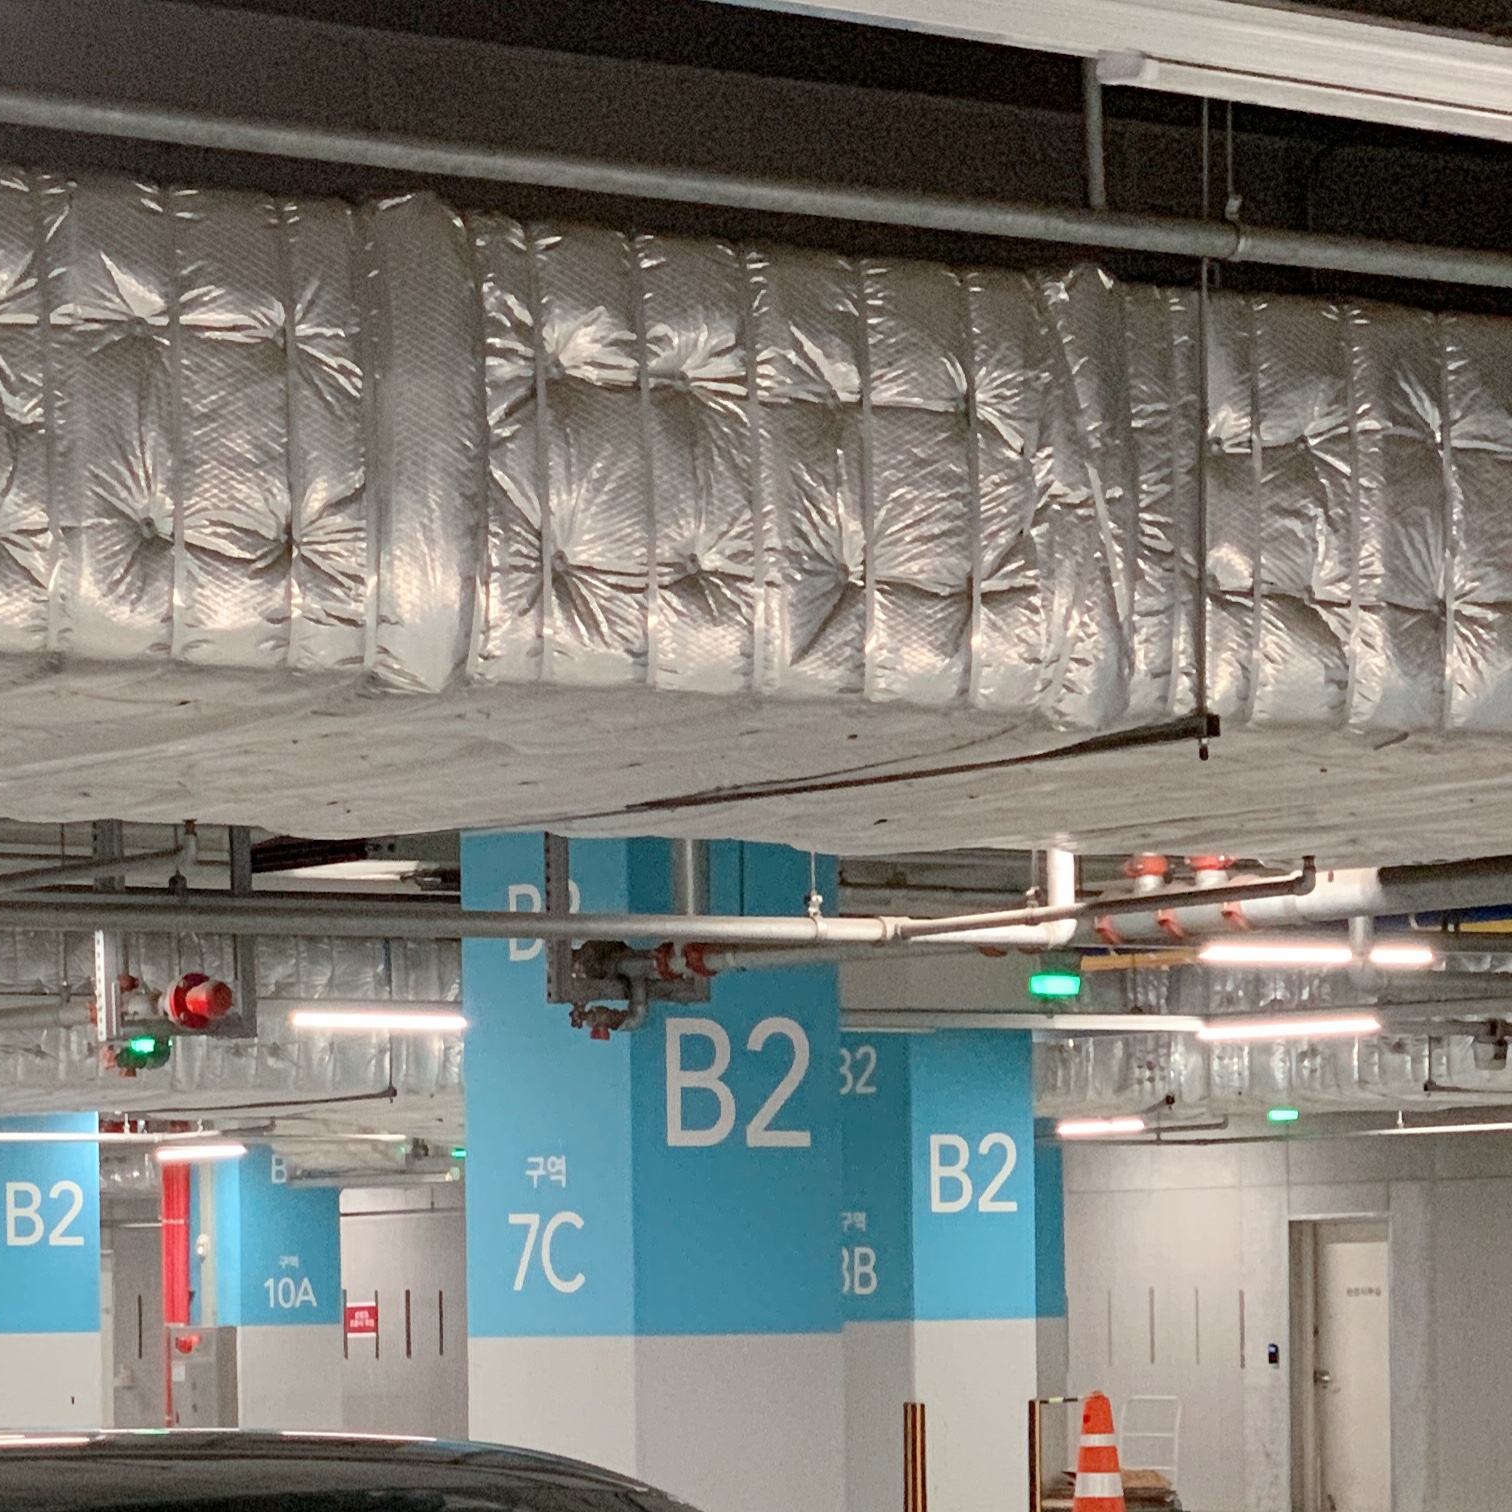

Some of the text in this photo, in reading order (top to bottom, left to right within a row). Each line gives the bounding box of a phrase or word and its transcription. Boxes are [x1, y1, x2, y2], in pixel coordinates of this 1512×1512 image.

[666, 1017, 811, 1147] B2
[271, 1154, 288, 1184] B
[525, 1155, 567, 1188] 구역
[929, 1132, 1018, 1213] B2
[5, 1180, 85, 1246] B2
[508, 1211, 586, 1293] 7C
[264, 1277, 317, 1309] 10A
